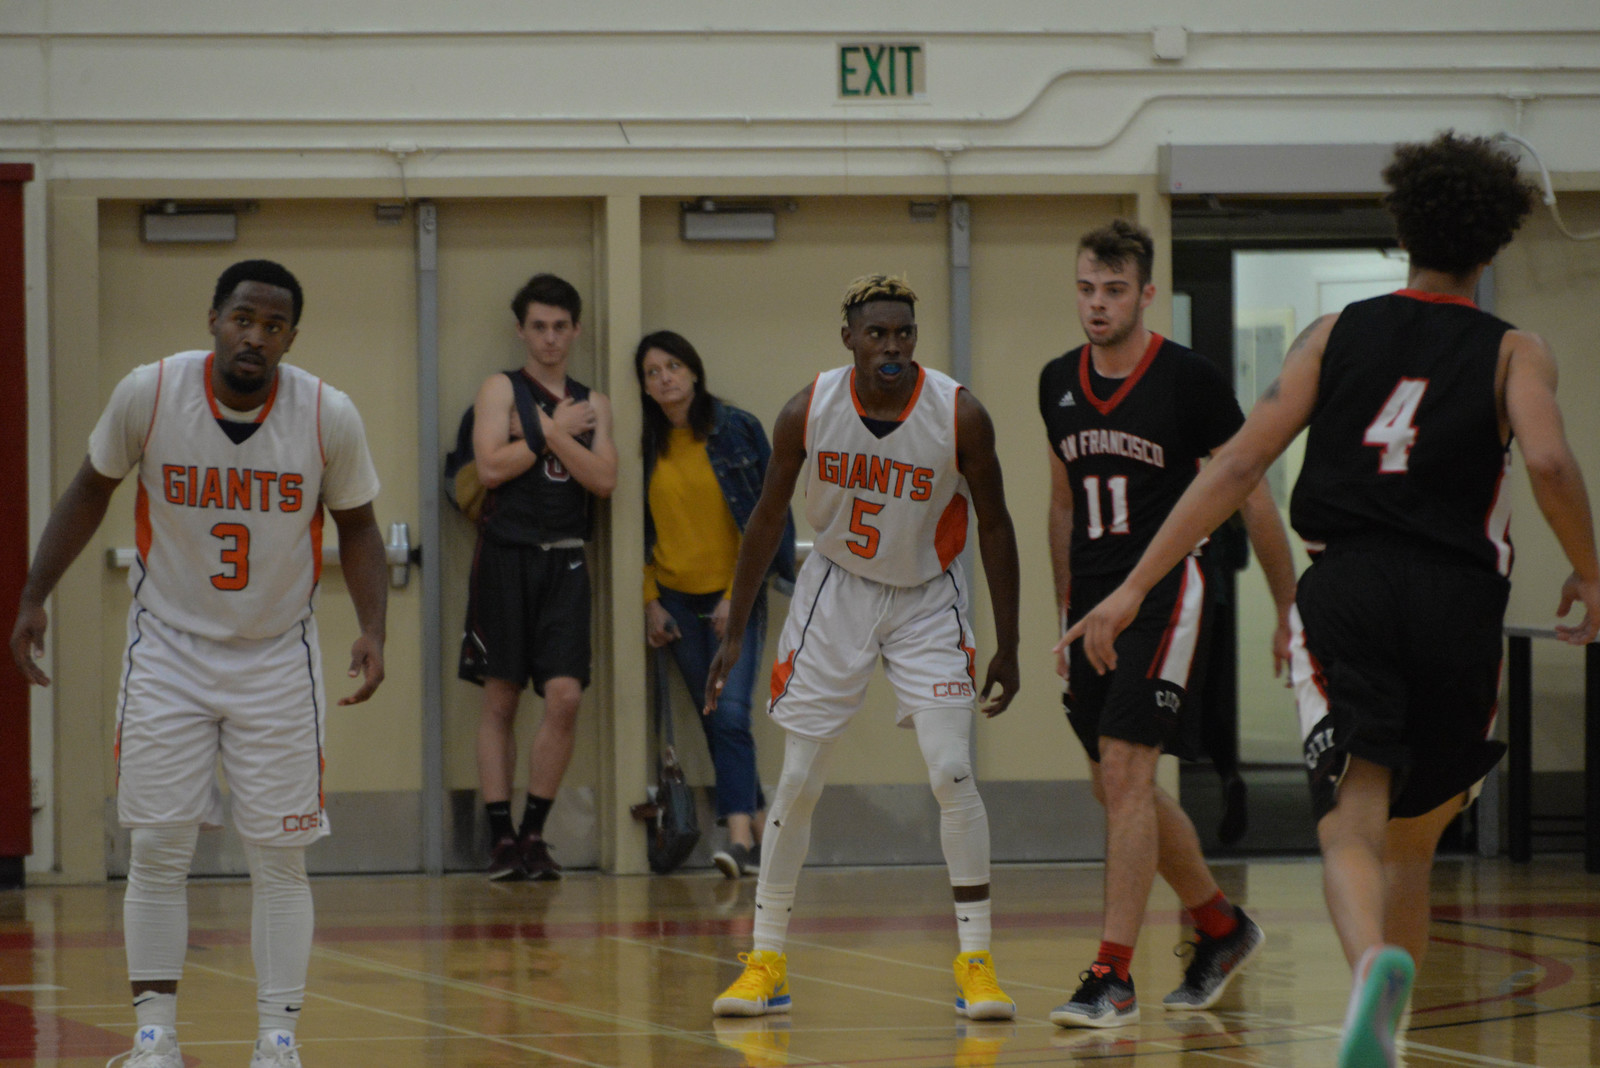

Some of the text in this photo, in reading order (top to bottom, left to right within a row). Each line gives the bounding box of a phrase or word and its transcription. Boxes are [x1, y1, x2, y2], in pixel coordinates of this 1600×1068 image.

[841, 45, 921, 96] EXIT
[1079, 428, 1165, 468] FRANCISCO
[1362, 376, 1430, 474] 4
[162, 464, 303, 513] GIANTS
[818, 451, 935, 501] GIANTS
[846, 497, 886, 559] 5
[1083, 475, 1130, 539] 11
[210, 522, 249, 591] 3
[933, 682, 972, 697] COS
[283, 811, 318, 831] COS
